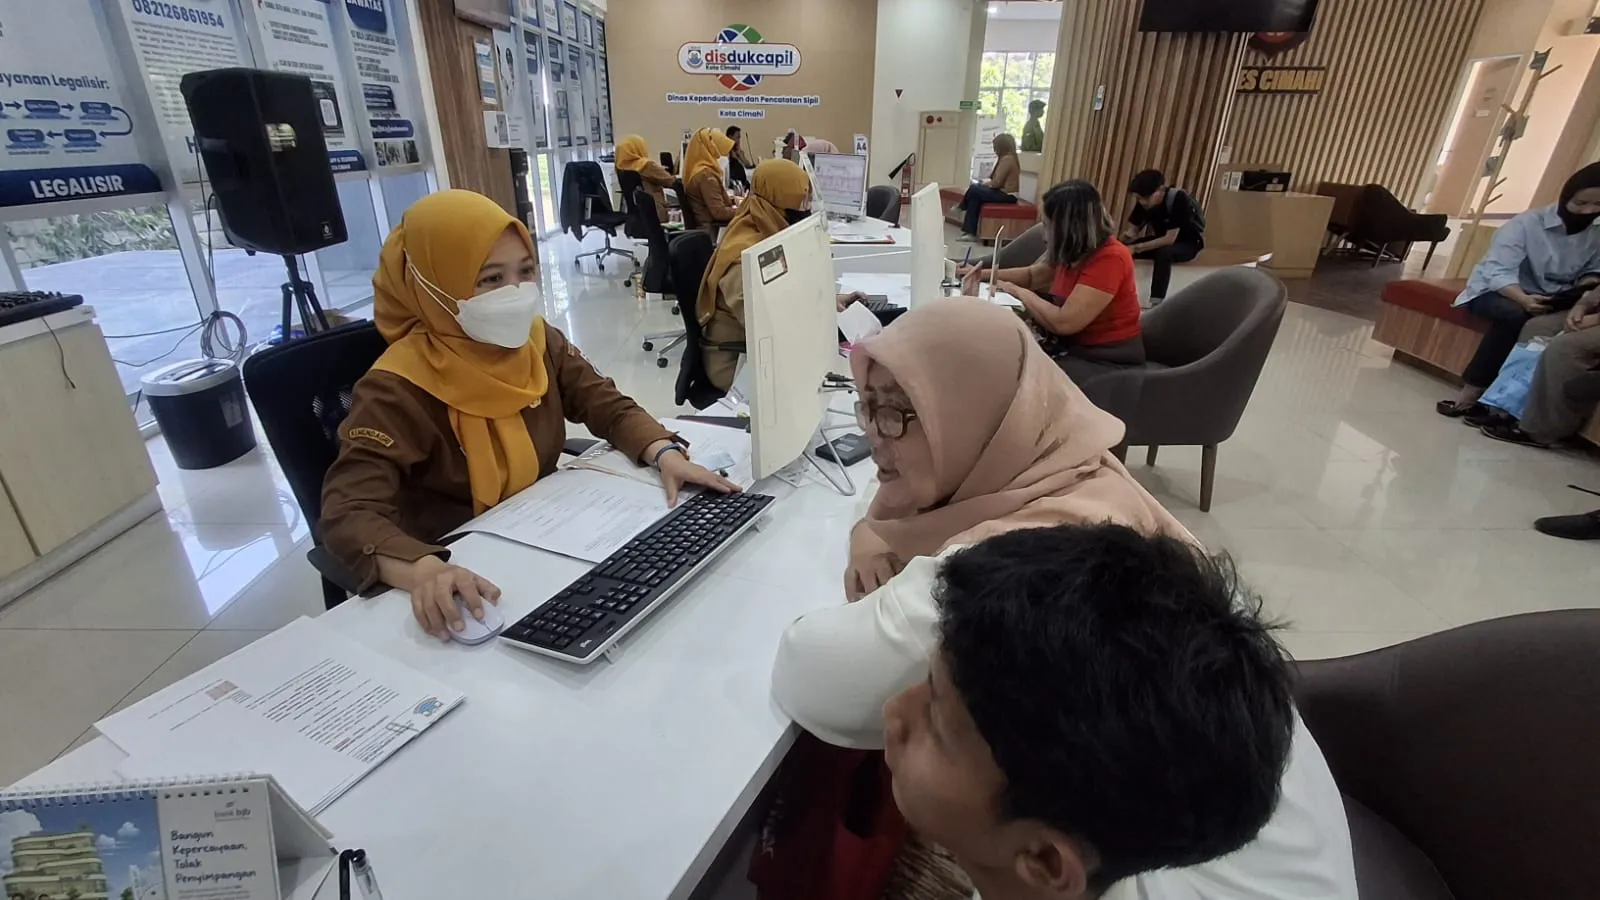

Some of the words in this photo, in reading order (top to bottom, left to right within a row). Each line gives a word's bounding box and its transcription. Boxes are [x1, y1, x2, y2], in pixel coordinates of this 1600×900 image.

[132, 0, 225, 28] 082126861954
[704, 49, 793, 68] disdukcapil
[1259, 69, 1324, 90] CIMAHI
[667, 94, 688, 102] Dinas
[689, 95, 744, 104] Kependudukan
[745, 95, 760, 103] dan
[760, 96, 802, 104] Pencatatan
[803, 97, 819, 105] Sipil
[30, 175, 124, 199] LEGALISIR
[170, 830, 214, 842] Bangun
[174, 859, 202, 869] Tolak
[175, 870, 257, 885] Penyimpangan
